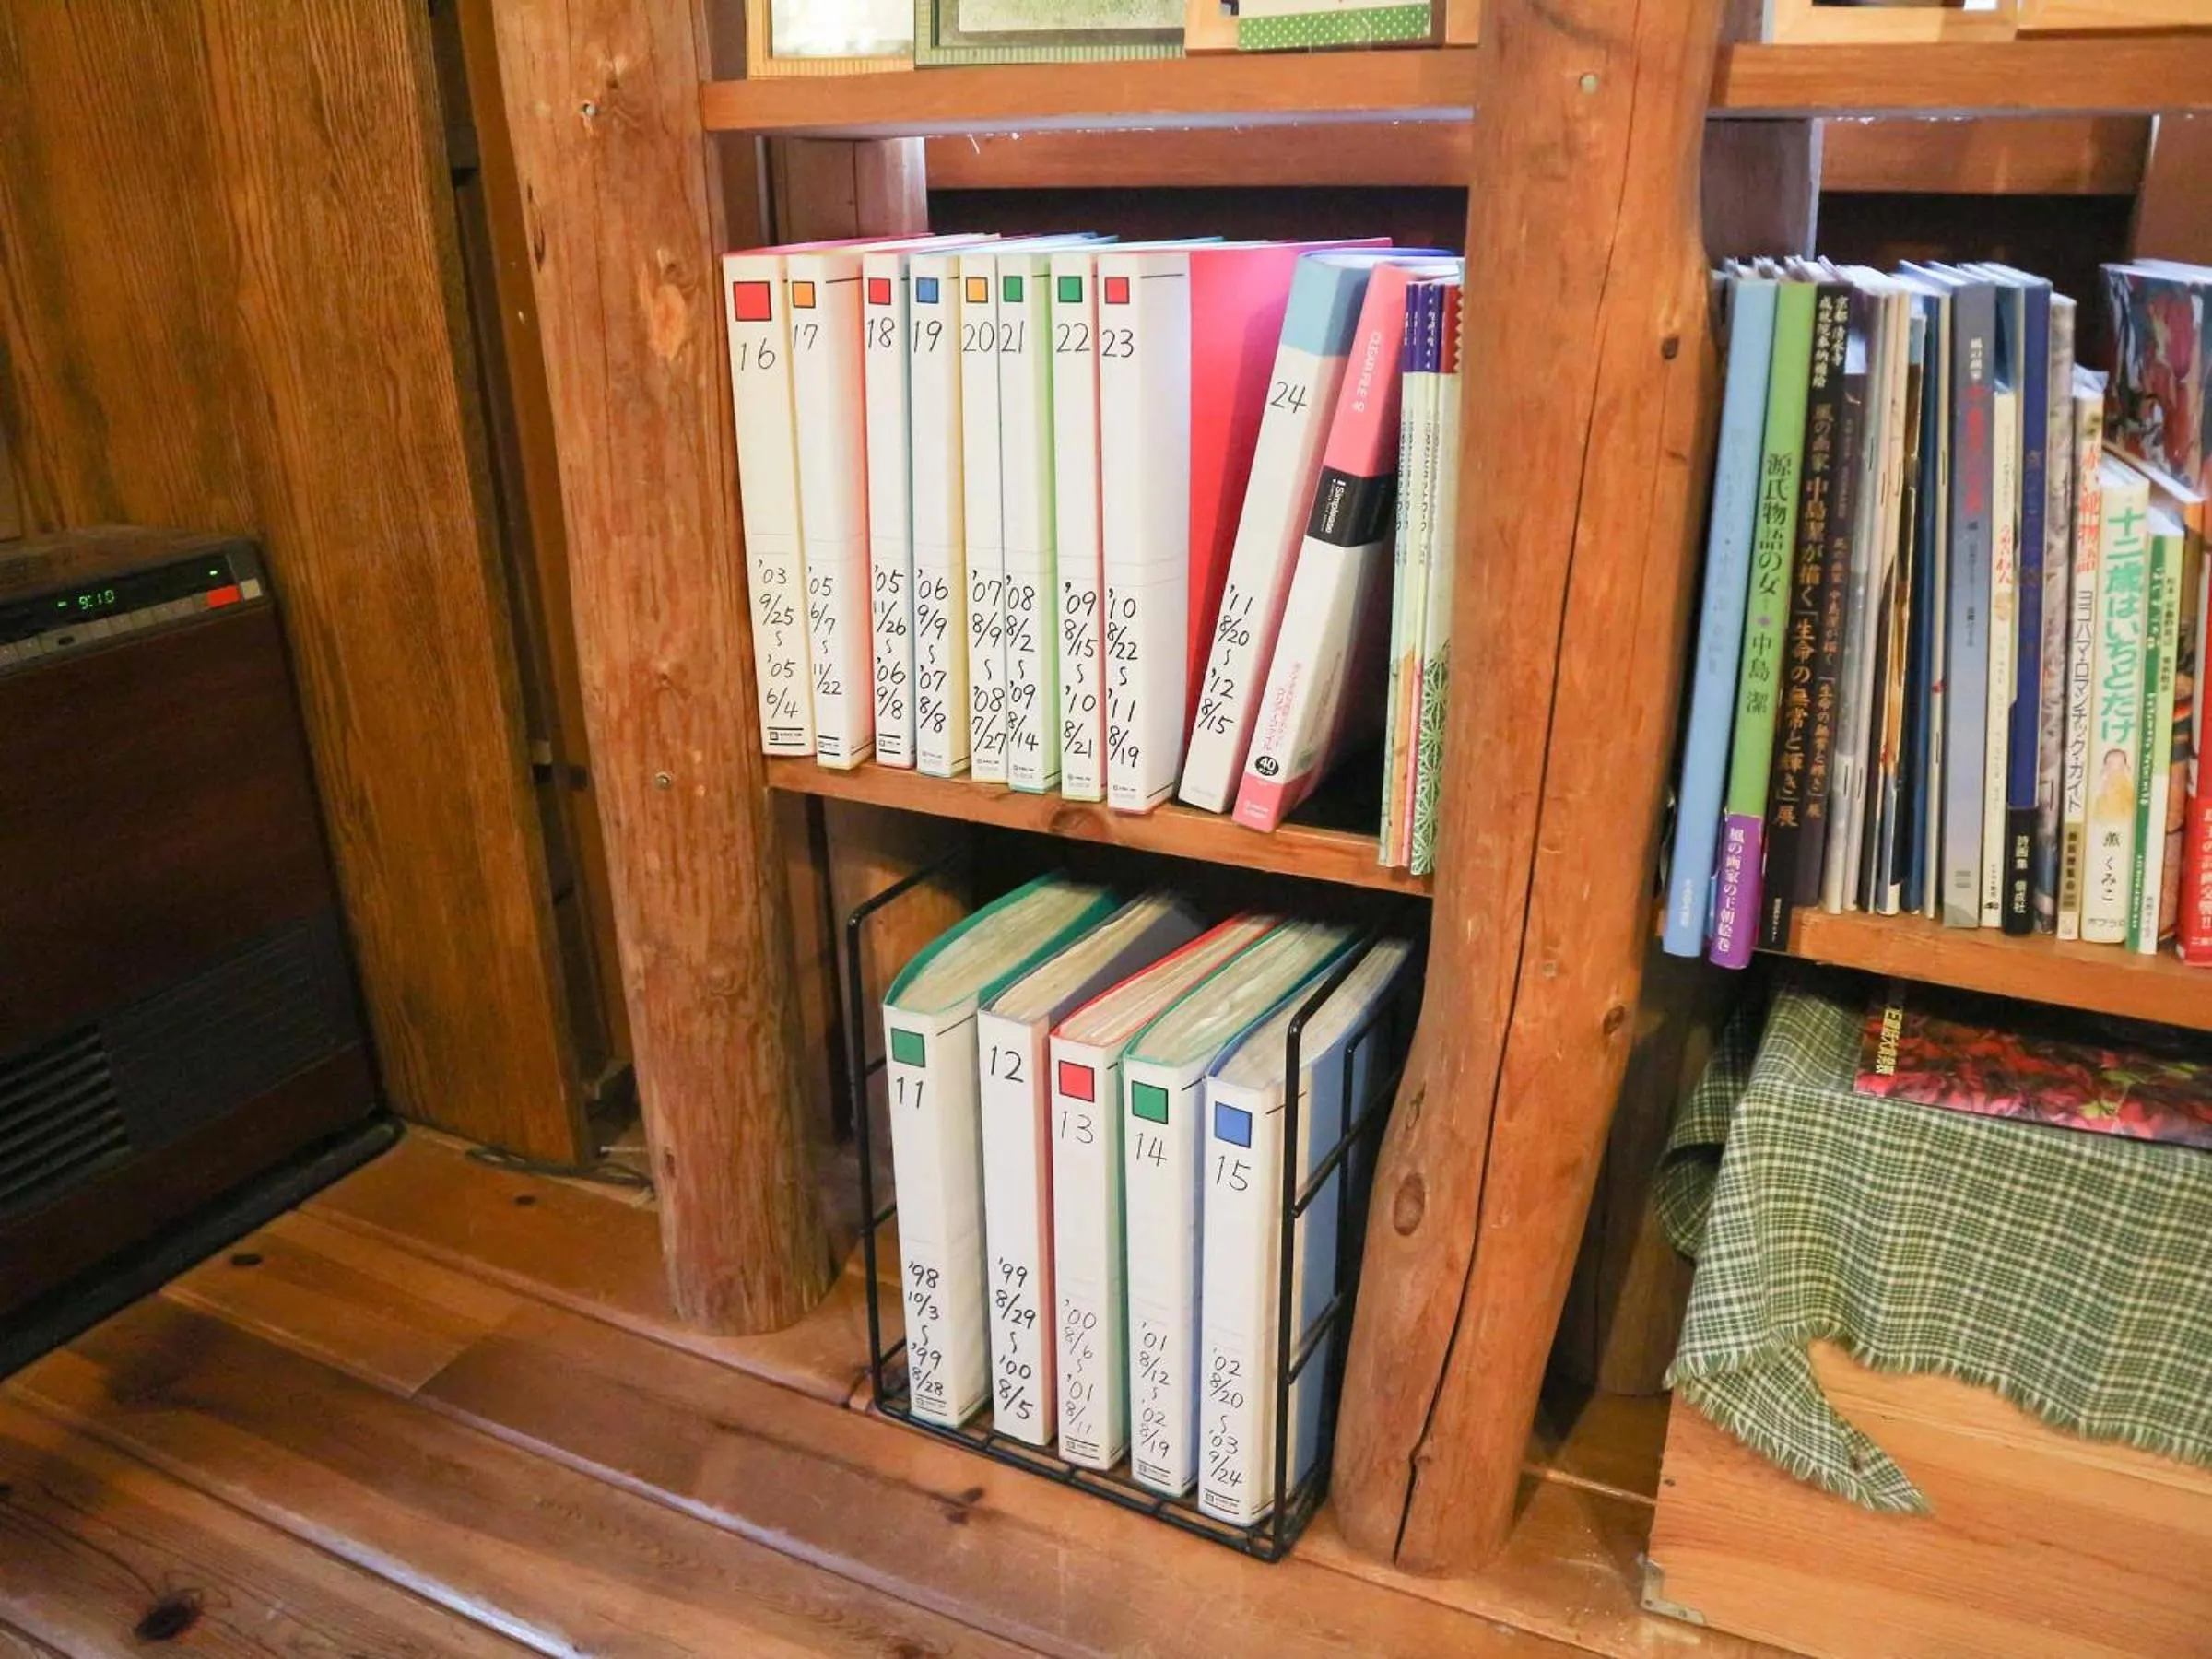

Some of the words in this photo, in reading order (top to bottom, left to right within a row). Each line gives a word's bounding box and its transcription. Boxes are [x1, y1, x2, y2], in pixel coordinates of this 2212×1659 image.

[792, 323, 819, 351] 17
[866, 315, 896, 350] 18
[912, 319, 944, 354] 19
[961, 320, 995, 354] 20
[1000, 319, 1025, 354] 21
[1055, 322, 1091, 354] 22
[1100, 328, 1135, 359] 23
[739, 337, 776, 372] 16
[1269, 380, 1308, 415] 24
[1758, 452, 1793, 596] 源氏物語の女
[757, 559, 788, 585] '03
[807, 565, 834, 598] '05
[874, 564, 905, 595] '05
[917, 568, 949, 601] '06
[971, 569, 1004, 606] '07
[77, 589, 115, 610] 9:10
[759, 592, 795, 627] 9/25
[1005, 573, 1036, 612] '08
[1064, 581, 1098, 618] '09
[1107, 586, 1137, 620] '10
[1229, 583, 1253, 616] '11
[809, 601, 837, 635] 6/7
[872, 599, 907, 636] 11/26
[917, 603, 948, 641] 9/9
[971, 611, 1003, 649] 8/9
[1006, 614, 1036, 653] 8/2
[1217, 614, 1251, 647] 8/20
[2100, 509, 2146, 745] 十二歳はいちどだけ
[1063, 618, 1099, 659] 8/15
[1106, 621, 1139, 662] 8/22
[766, 653, 796, 679] '05
[813, 663, 843, 696] 11/22
[876, 656, 907, 686] '06
[919, 664, 947, 692] '07
[1208, 667, 1235, 700] '12
[765, 686, 799, 720] 6/4
[876, 685, 905, 721] 9/8
[972, 685, 1006, 713] '08
[1008, 679, 1036, 710] '09
[1064, 684, 1097, 714] '10
[1106, 688, 1136, 723] '11
[919, 695, 947, 734] 8/8
[1006, 710, 1040, 752] 8/14
[1197, 698, 1235, 735] 8/15
[971, 713, 1007, 756] 7/27
[1063, 719, 1093, 759] 8/21
[1107, 724, 1141, 769] 8/19
[1260, 757, 1277, 771] 40
[988, 1045, 1025, 1084] 12
[895, 1075, 925, 1110] 11
[1059, 1110, 1095, 1145] 13
[1134, 1132, 1169, 1168] 14
[1216, 1154, 1252, 1192] 15
[907, 1260, 940, 1289] '98
[998, 1255, 1029, 1288] '99
[907, 1290, 941, 1322] 10/3
[995, 1288, 1037, 1330] 8/29
[1064, 1298, 1097, 1331] '00
[1064, 1326, 1094, 1359] 8/6
[1141, 1321, 1168, 1351] '01
[910, 1342, 942, 1371] '99
[998, 1354, 1032, 1381] '00
[1138, 1350, 1171, 1386] 8/12
[1212, 1347, 1242, 1378] '02
[911, 1365, 945, 1397] 8/28
[1066, 1373, 1094, 1403] '01
[1208, 1371, 1244, 1409] 8/20
[997, 1377, 1034, 1421] 8/5
[1141, 1398, 1167, 1428] '02
[1065, 1400, 1092, 1436] 8/11
[1138, 1422, 1171, 1460] 8/19
[1208, 1429, 1240, 1456] '03
[1207, 1450, 1243, 1488] 9/24
